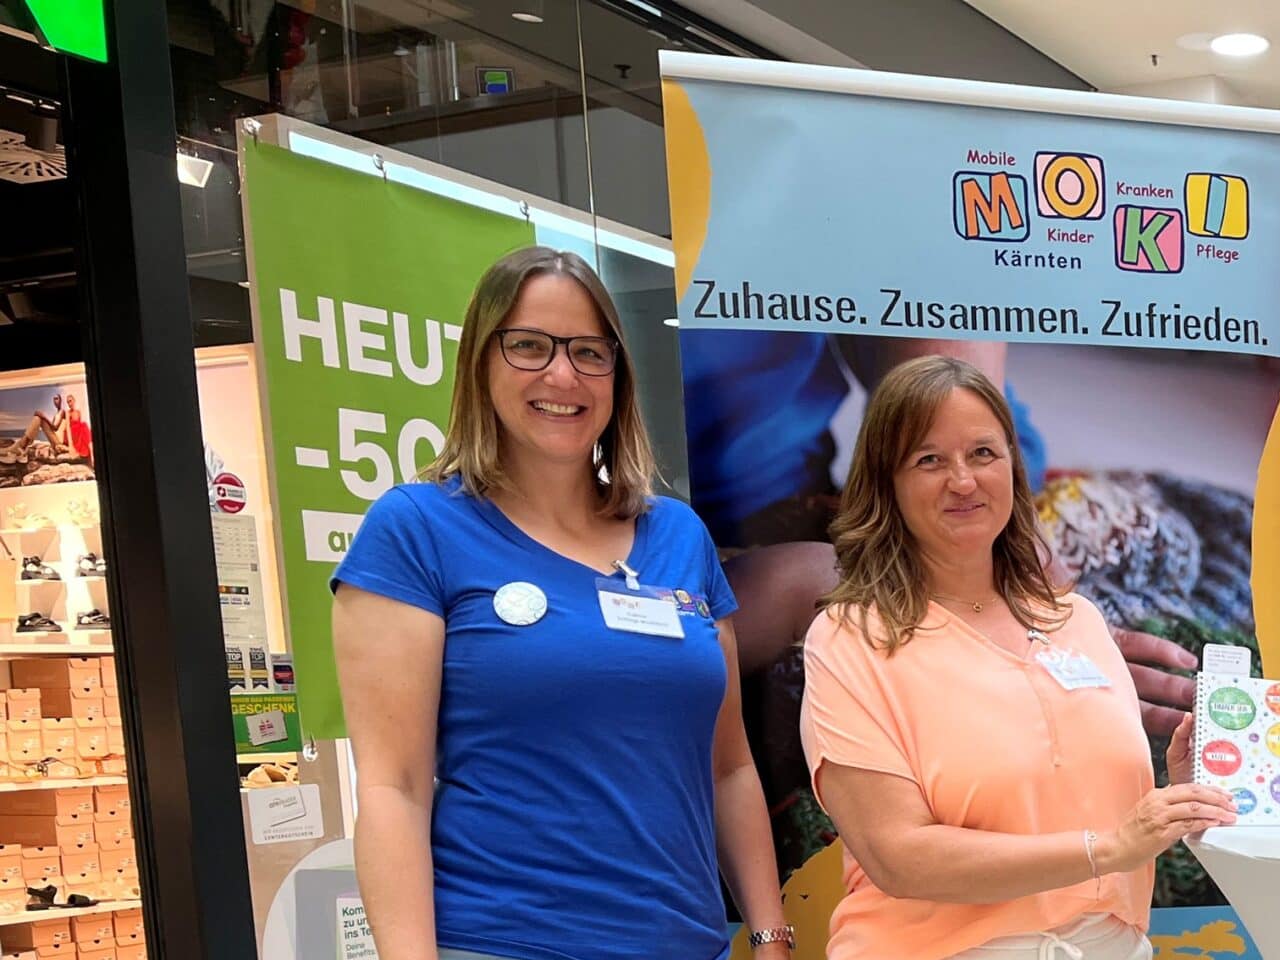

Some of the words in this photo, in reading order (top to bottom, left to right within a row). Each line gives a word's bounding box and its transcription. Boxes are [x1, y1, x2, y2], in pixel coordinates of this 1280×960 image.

[967, 150, 1016, 167] Mobile
[1116, 181, 1174, 199] Kranken
[1047, 228, 1094, 244] Kinder
[994, 249, 1082, 270] Kärnten
[1196, 243, 1240, 261] Pflege
[693, 280, 867, 324] Zuhause.
[880, 288, 1089, 335] Zusammen.
[1101, 299, 1269, 346] Zufrieden.
